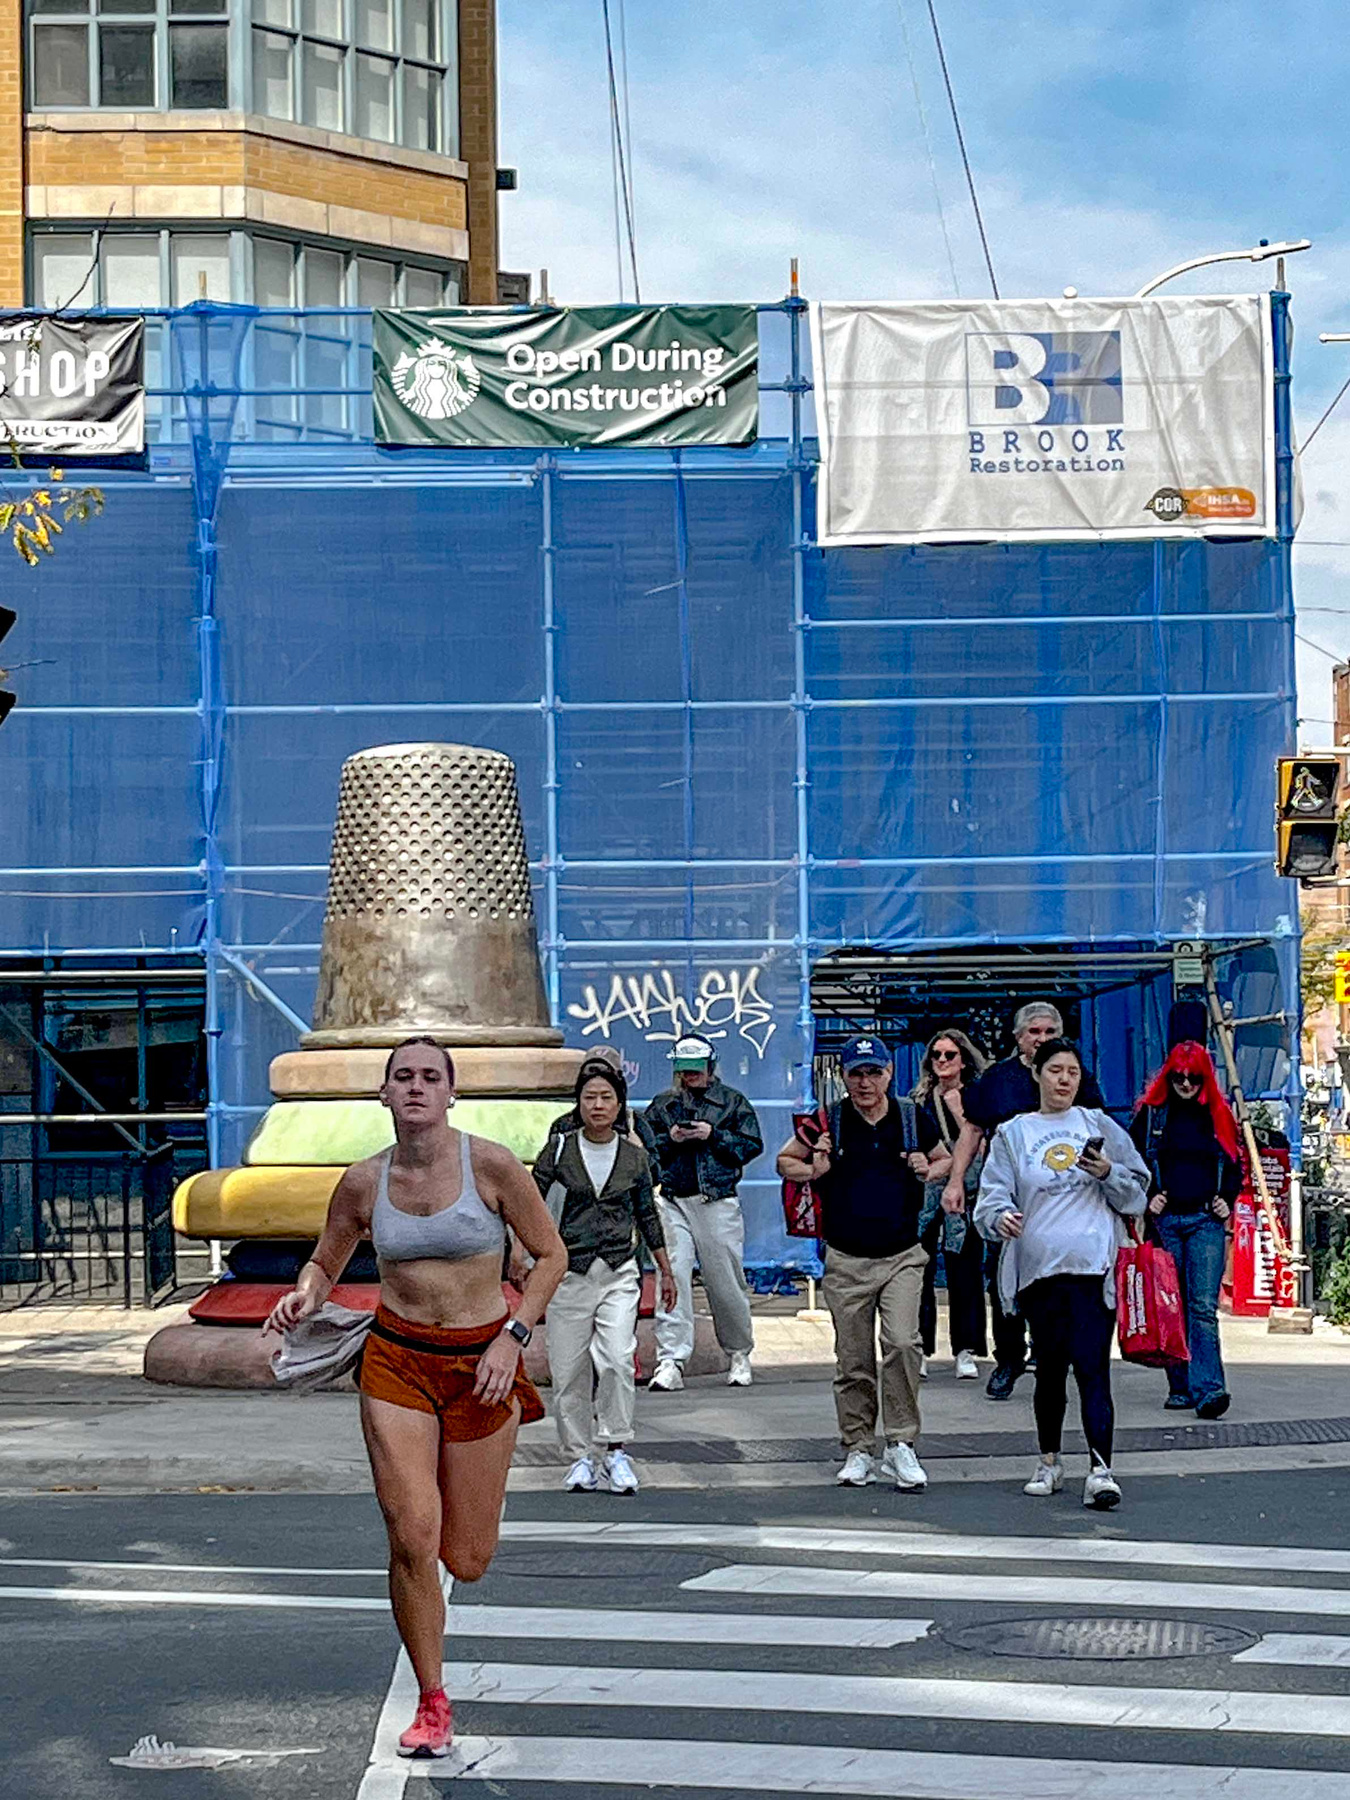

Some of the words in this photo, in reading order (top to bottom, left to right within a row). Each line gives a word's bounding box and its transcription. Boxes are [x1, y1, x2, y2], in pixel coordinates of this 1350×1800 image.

[0, 350, 110, 398] HOP
[507, 343, 602, 379] Open
[612, 341, 725, 378] During
[504, 379, 728, 411] Construction
[968, 429, 1125, 454] BROOK
[969, 455, 1126, 473] Restoration
